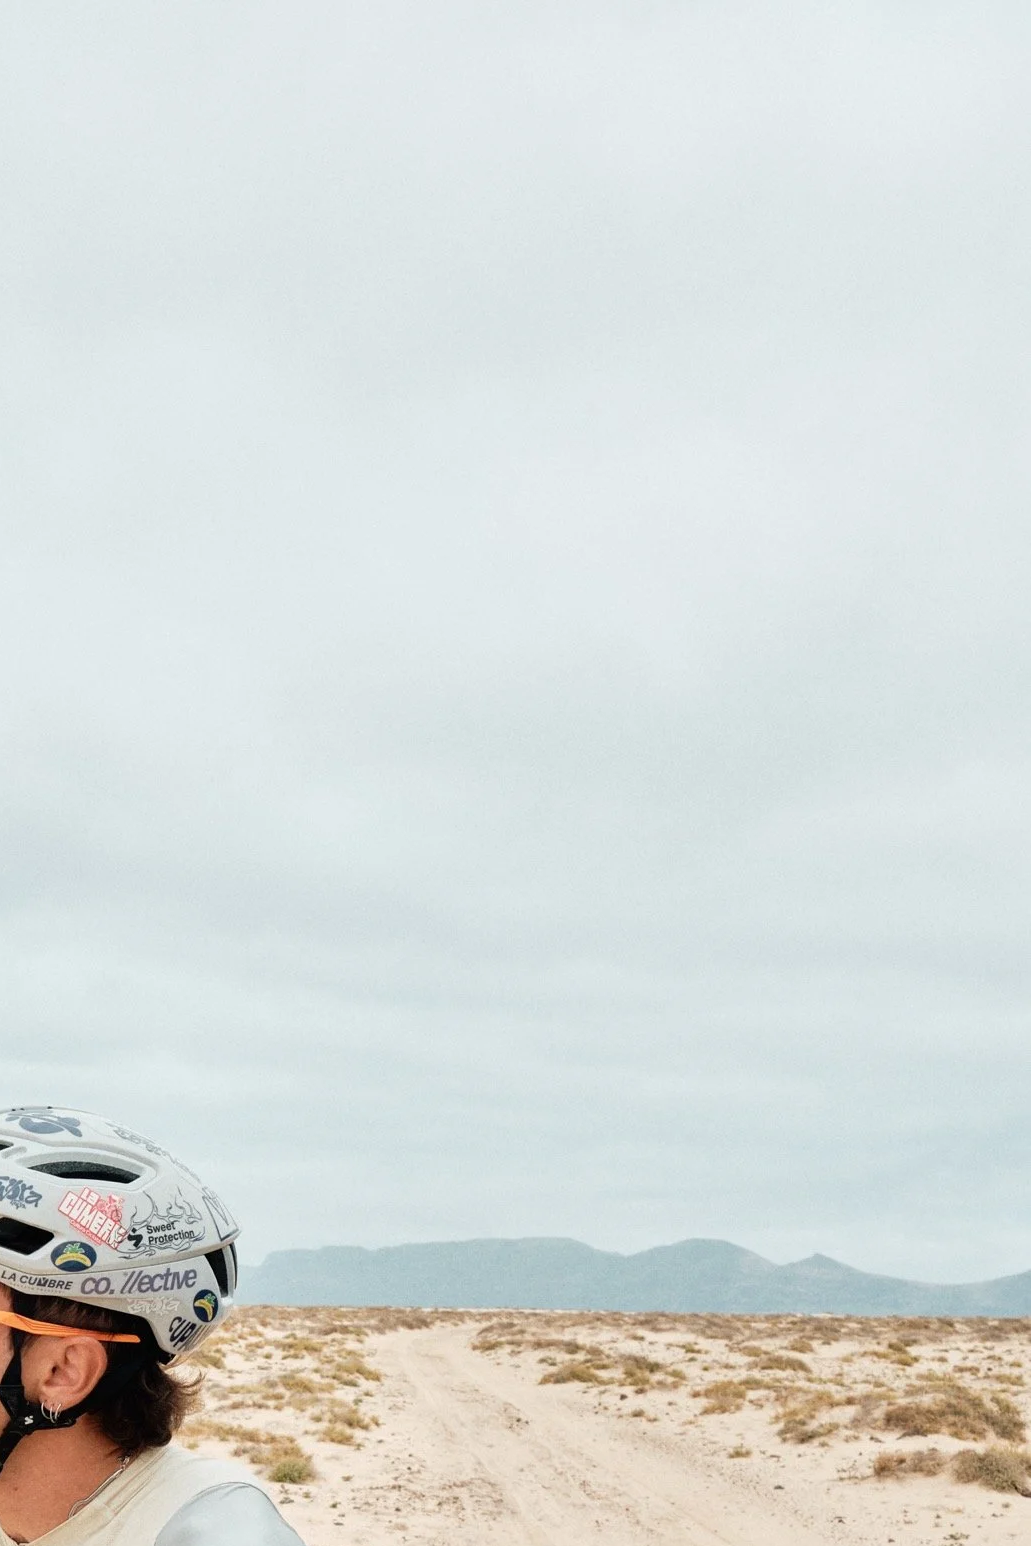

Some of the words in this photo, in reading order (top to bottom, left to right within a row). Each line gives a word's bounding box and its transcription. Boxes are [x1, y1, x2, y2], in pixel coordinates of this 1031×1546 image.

[146, 1222, 176, 1234] Sweet
[148, 1229, 195, 1245] Protection
[0, 1270, 17, 1282] LA
[19, 1275, 74, 1290] CUMBRE
